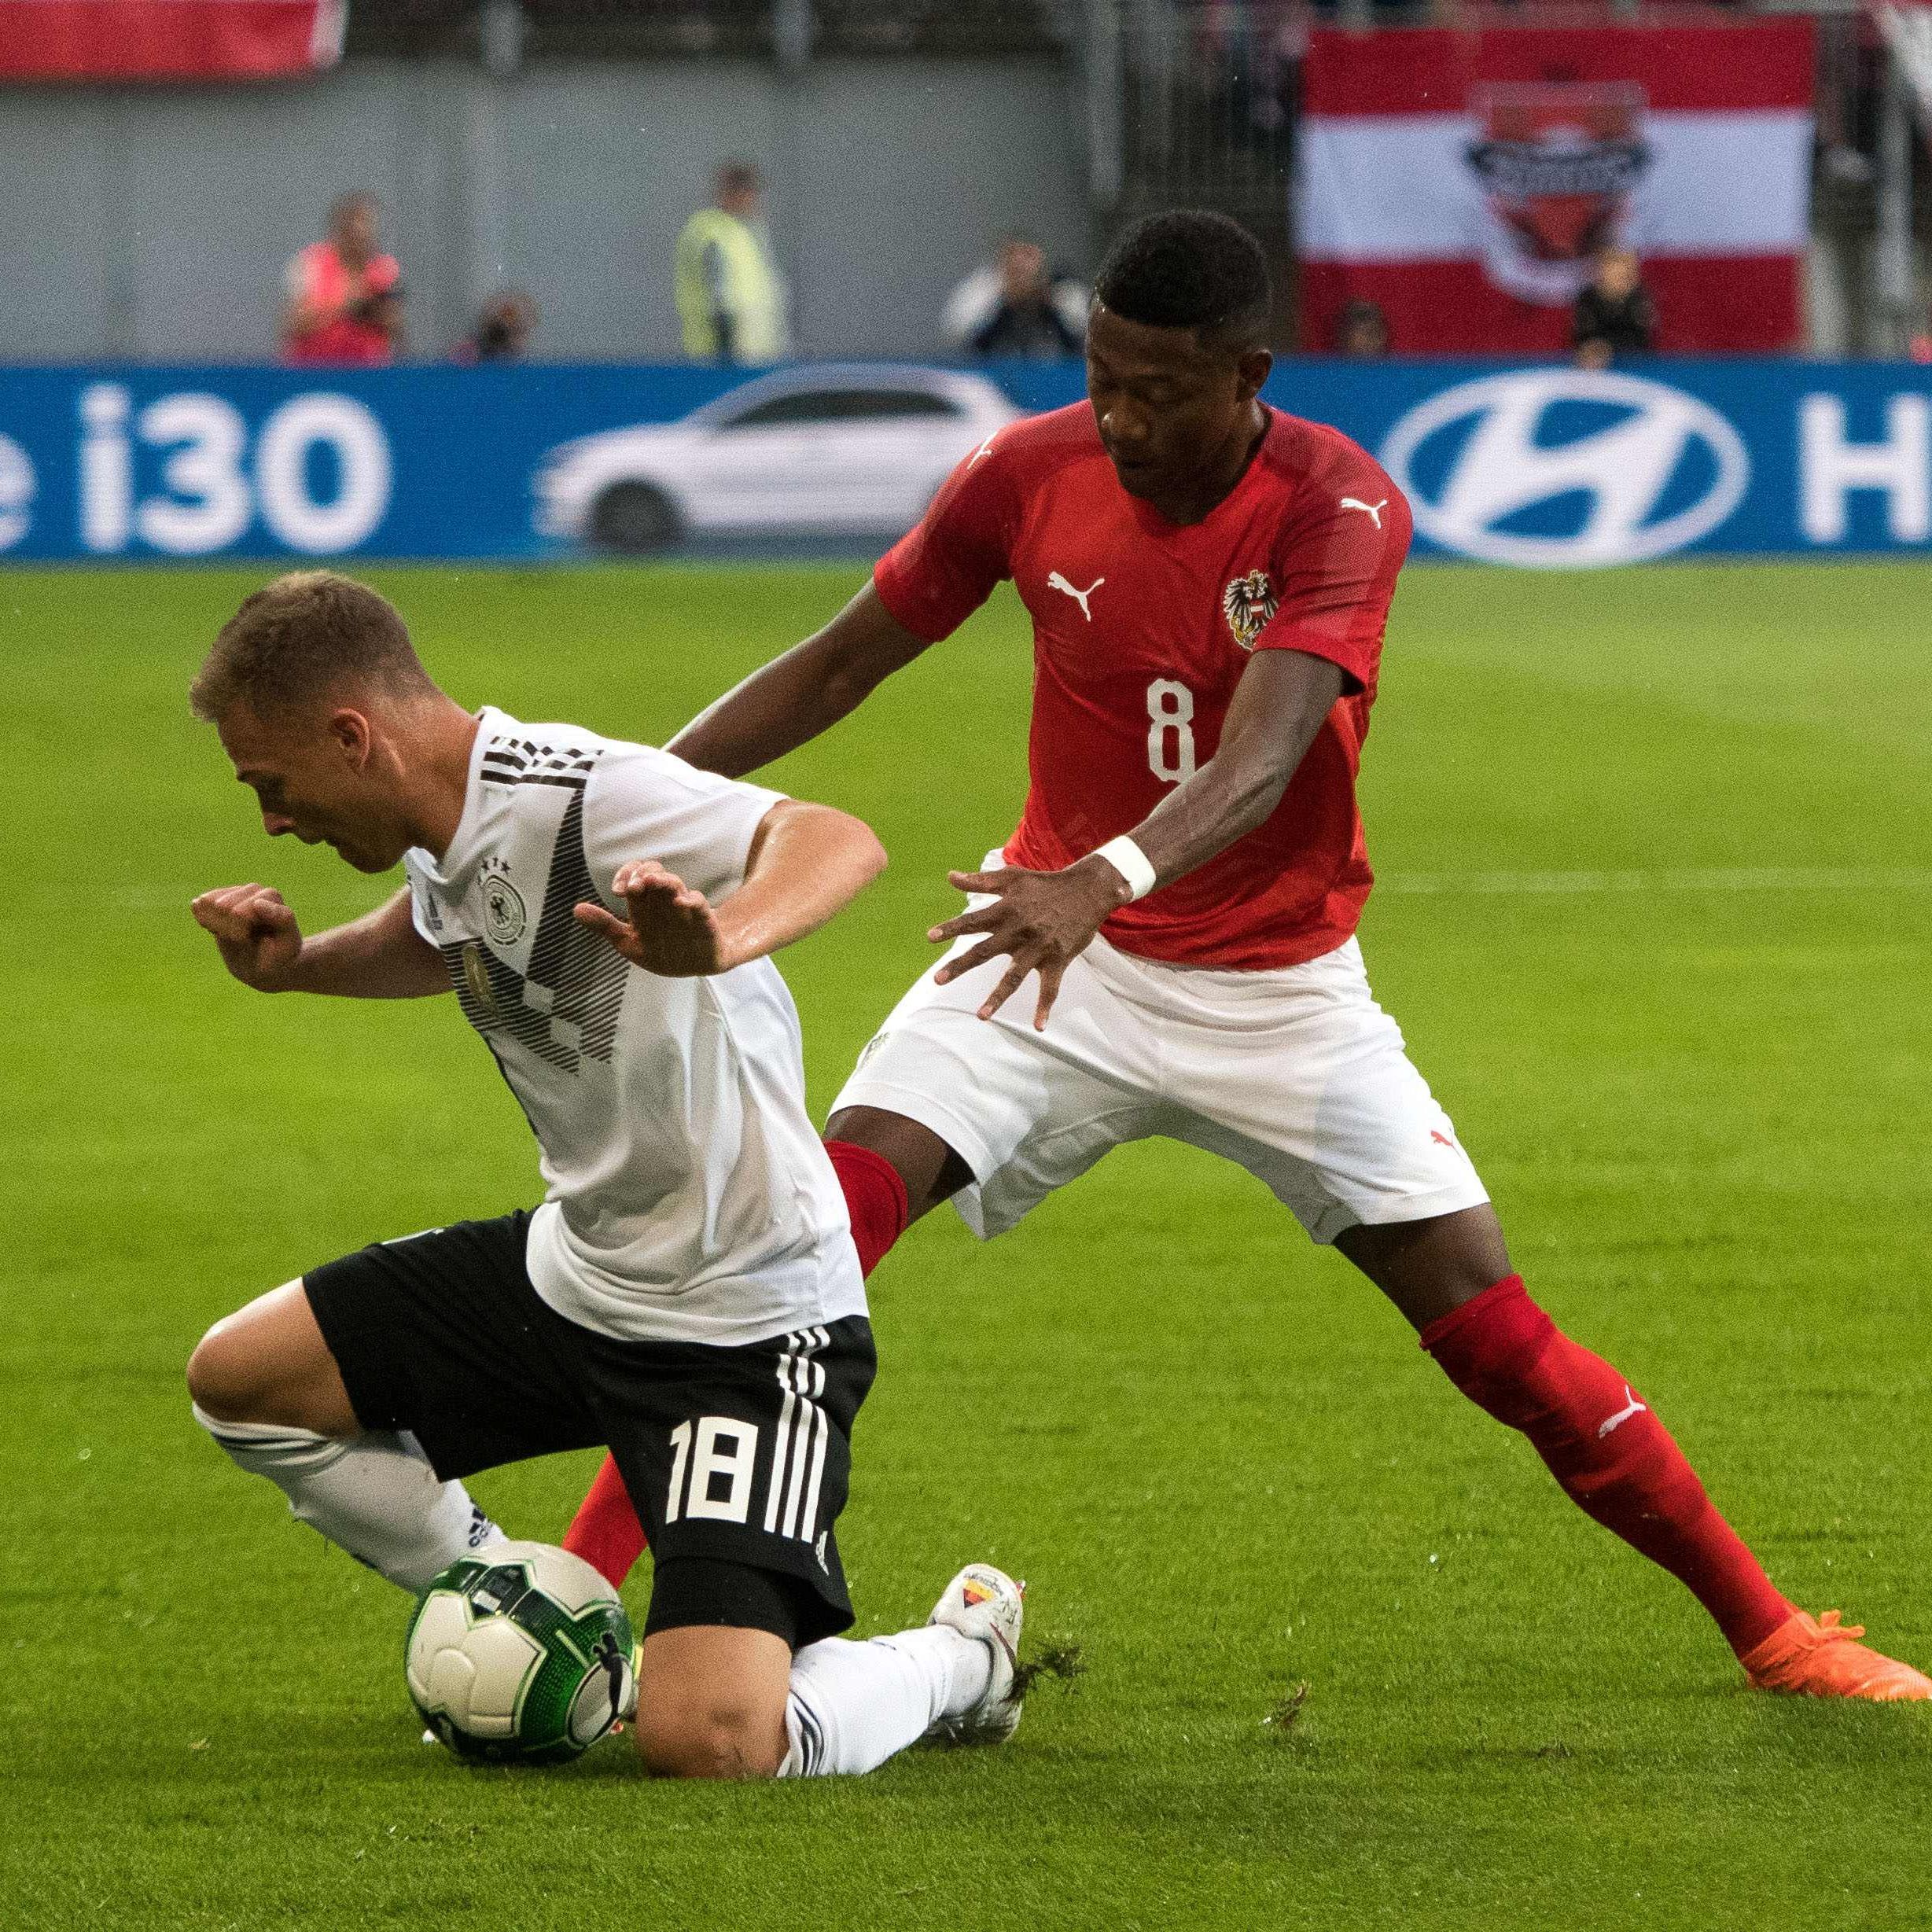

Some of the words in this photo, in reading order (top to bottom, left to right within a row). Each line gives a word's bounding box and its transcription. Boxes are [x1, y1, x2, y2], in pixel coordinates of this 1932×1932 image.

[80, 383, 391, 553] i30
[1147, 679, 1195, 785] 8
[666, 1417, 758, 1524] 18
